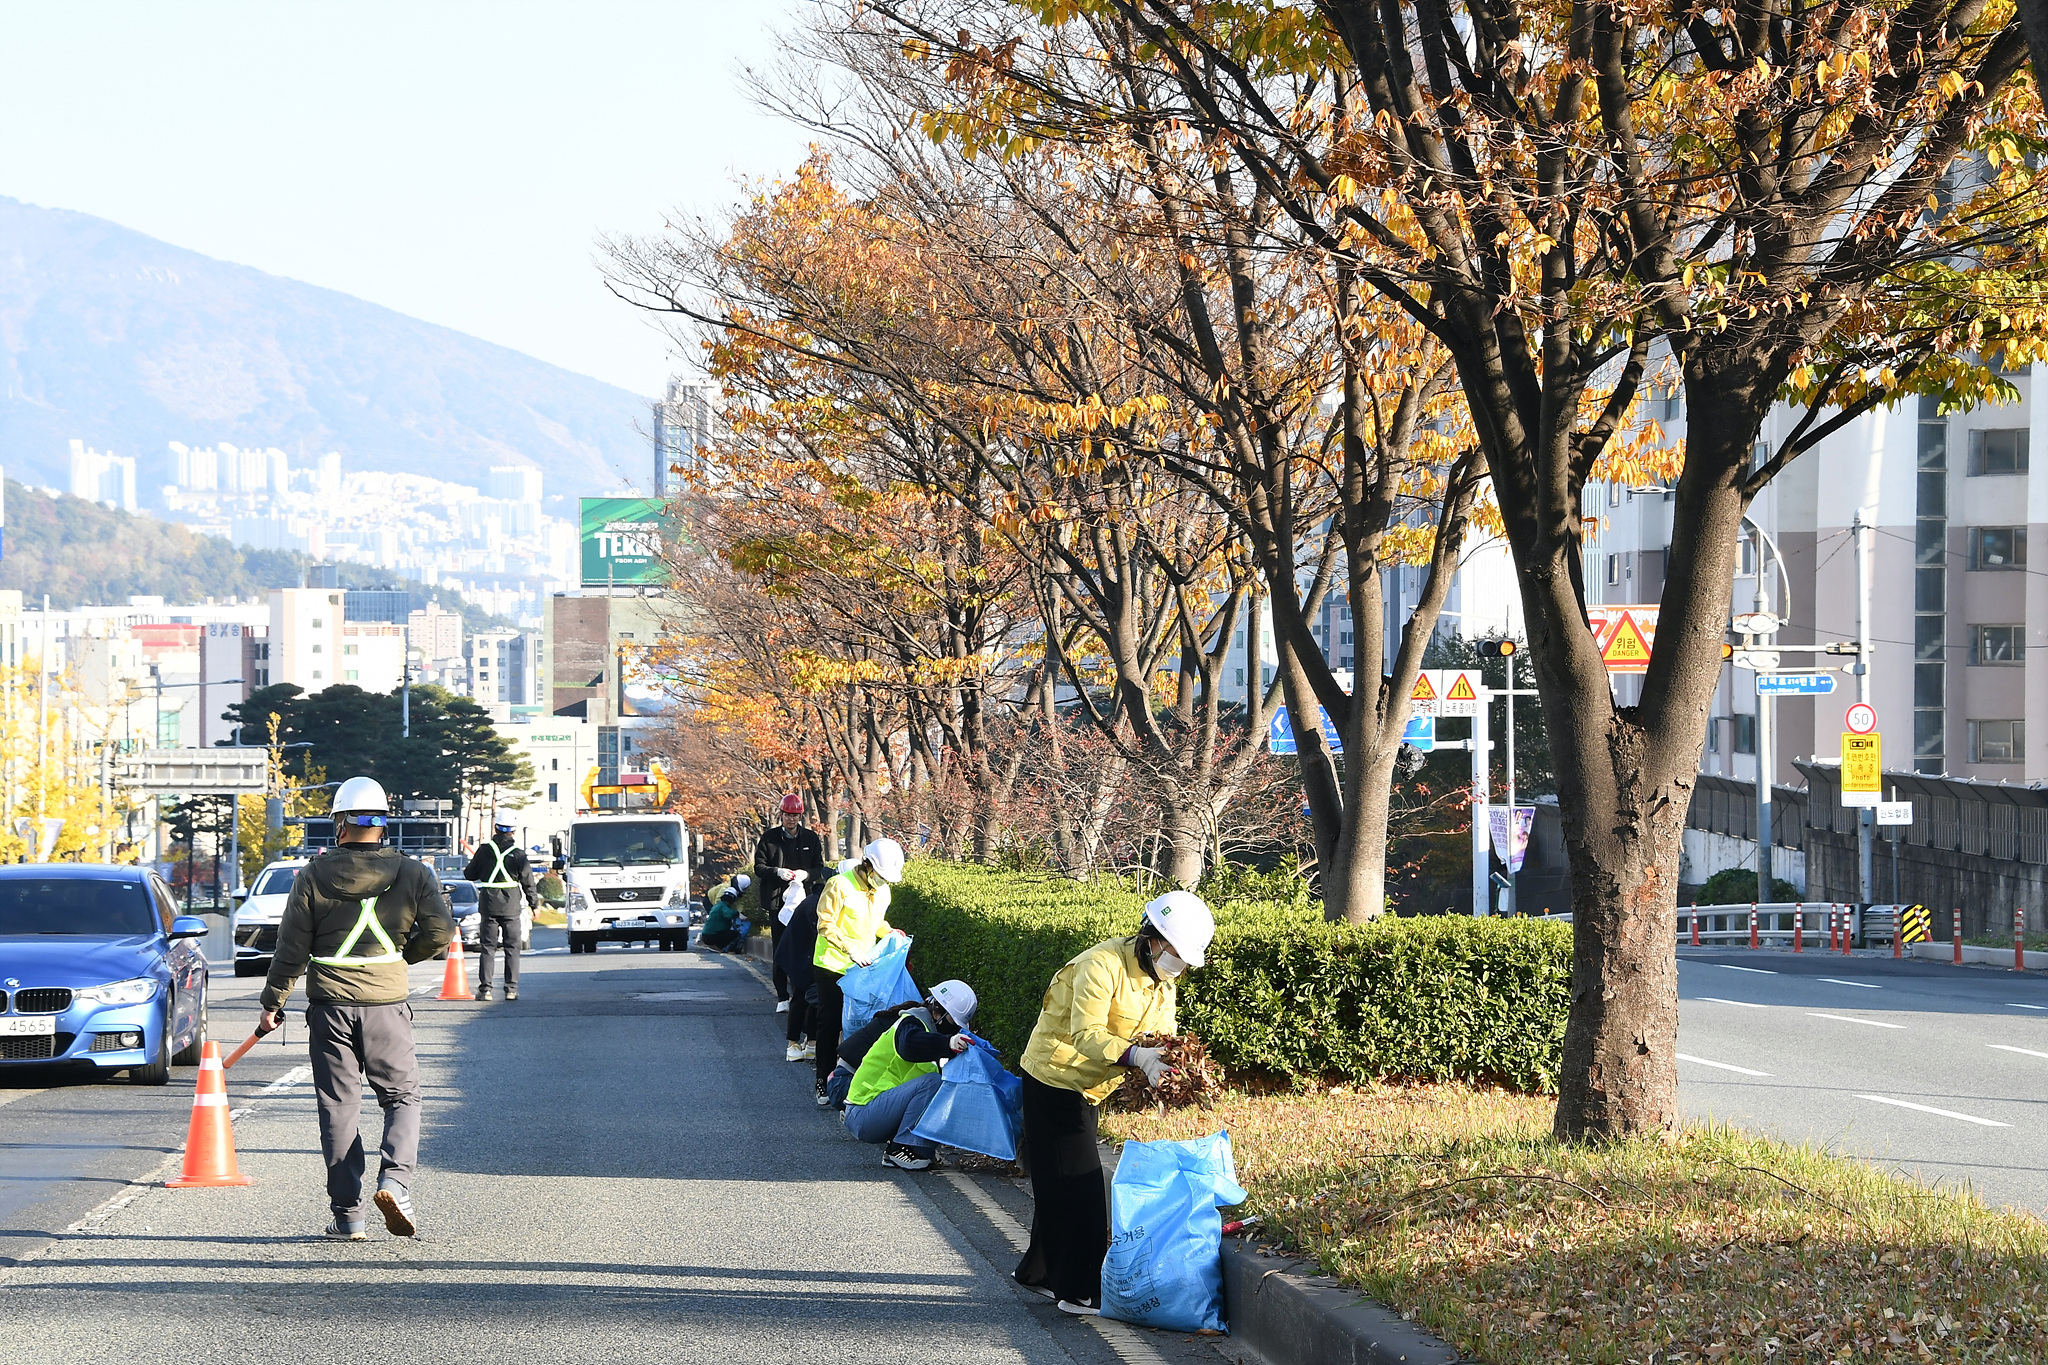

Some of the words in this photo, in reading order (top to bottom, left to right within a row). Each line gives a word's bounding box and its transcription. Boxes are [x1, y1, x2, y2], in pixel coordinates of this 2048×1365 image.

[1616, 638, 1636, 649] 위험
[1445, 702, 1477, 714] 노폭좁아짐
[1853, 713, 1869, 726] 50
[9, 1020, 46, 1032] 4565
[1112, 1226, 1145, 1246] 수거용
